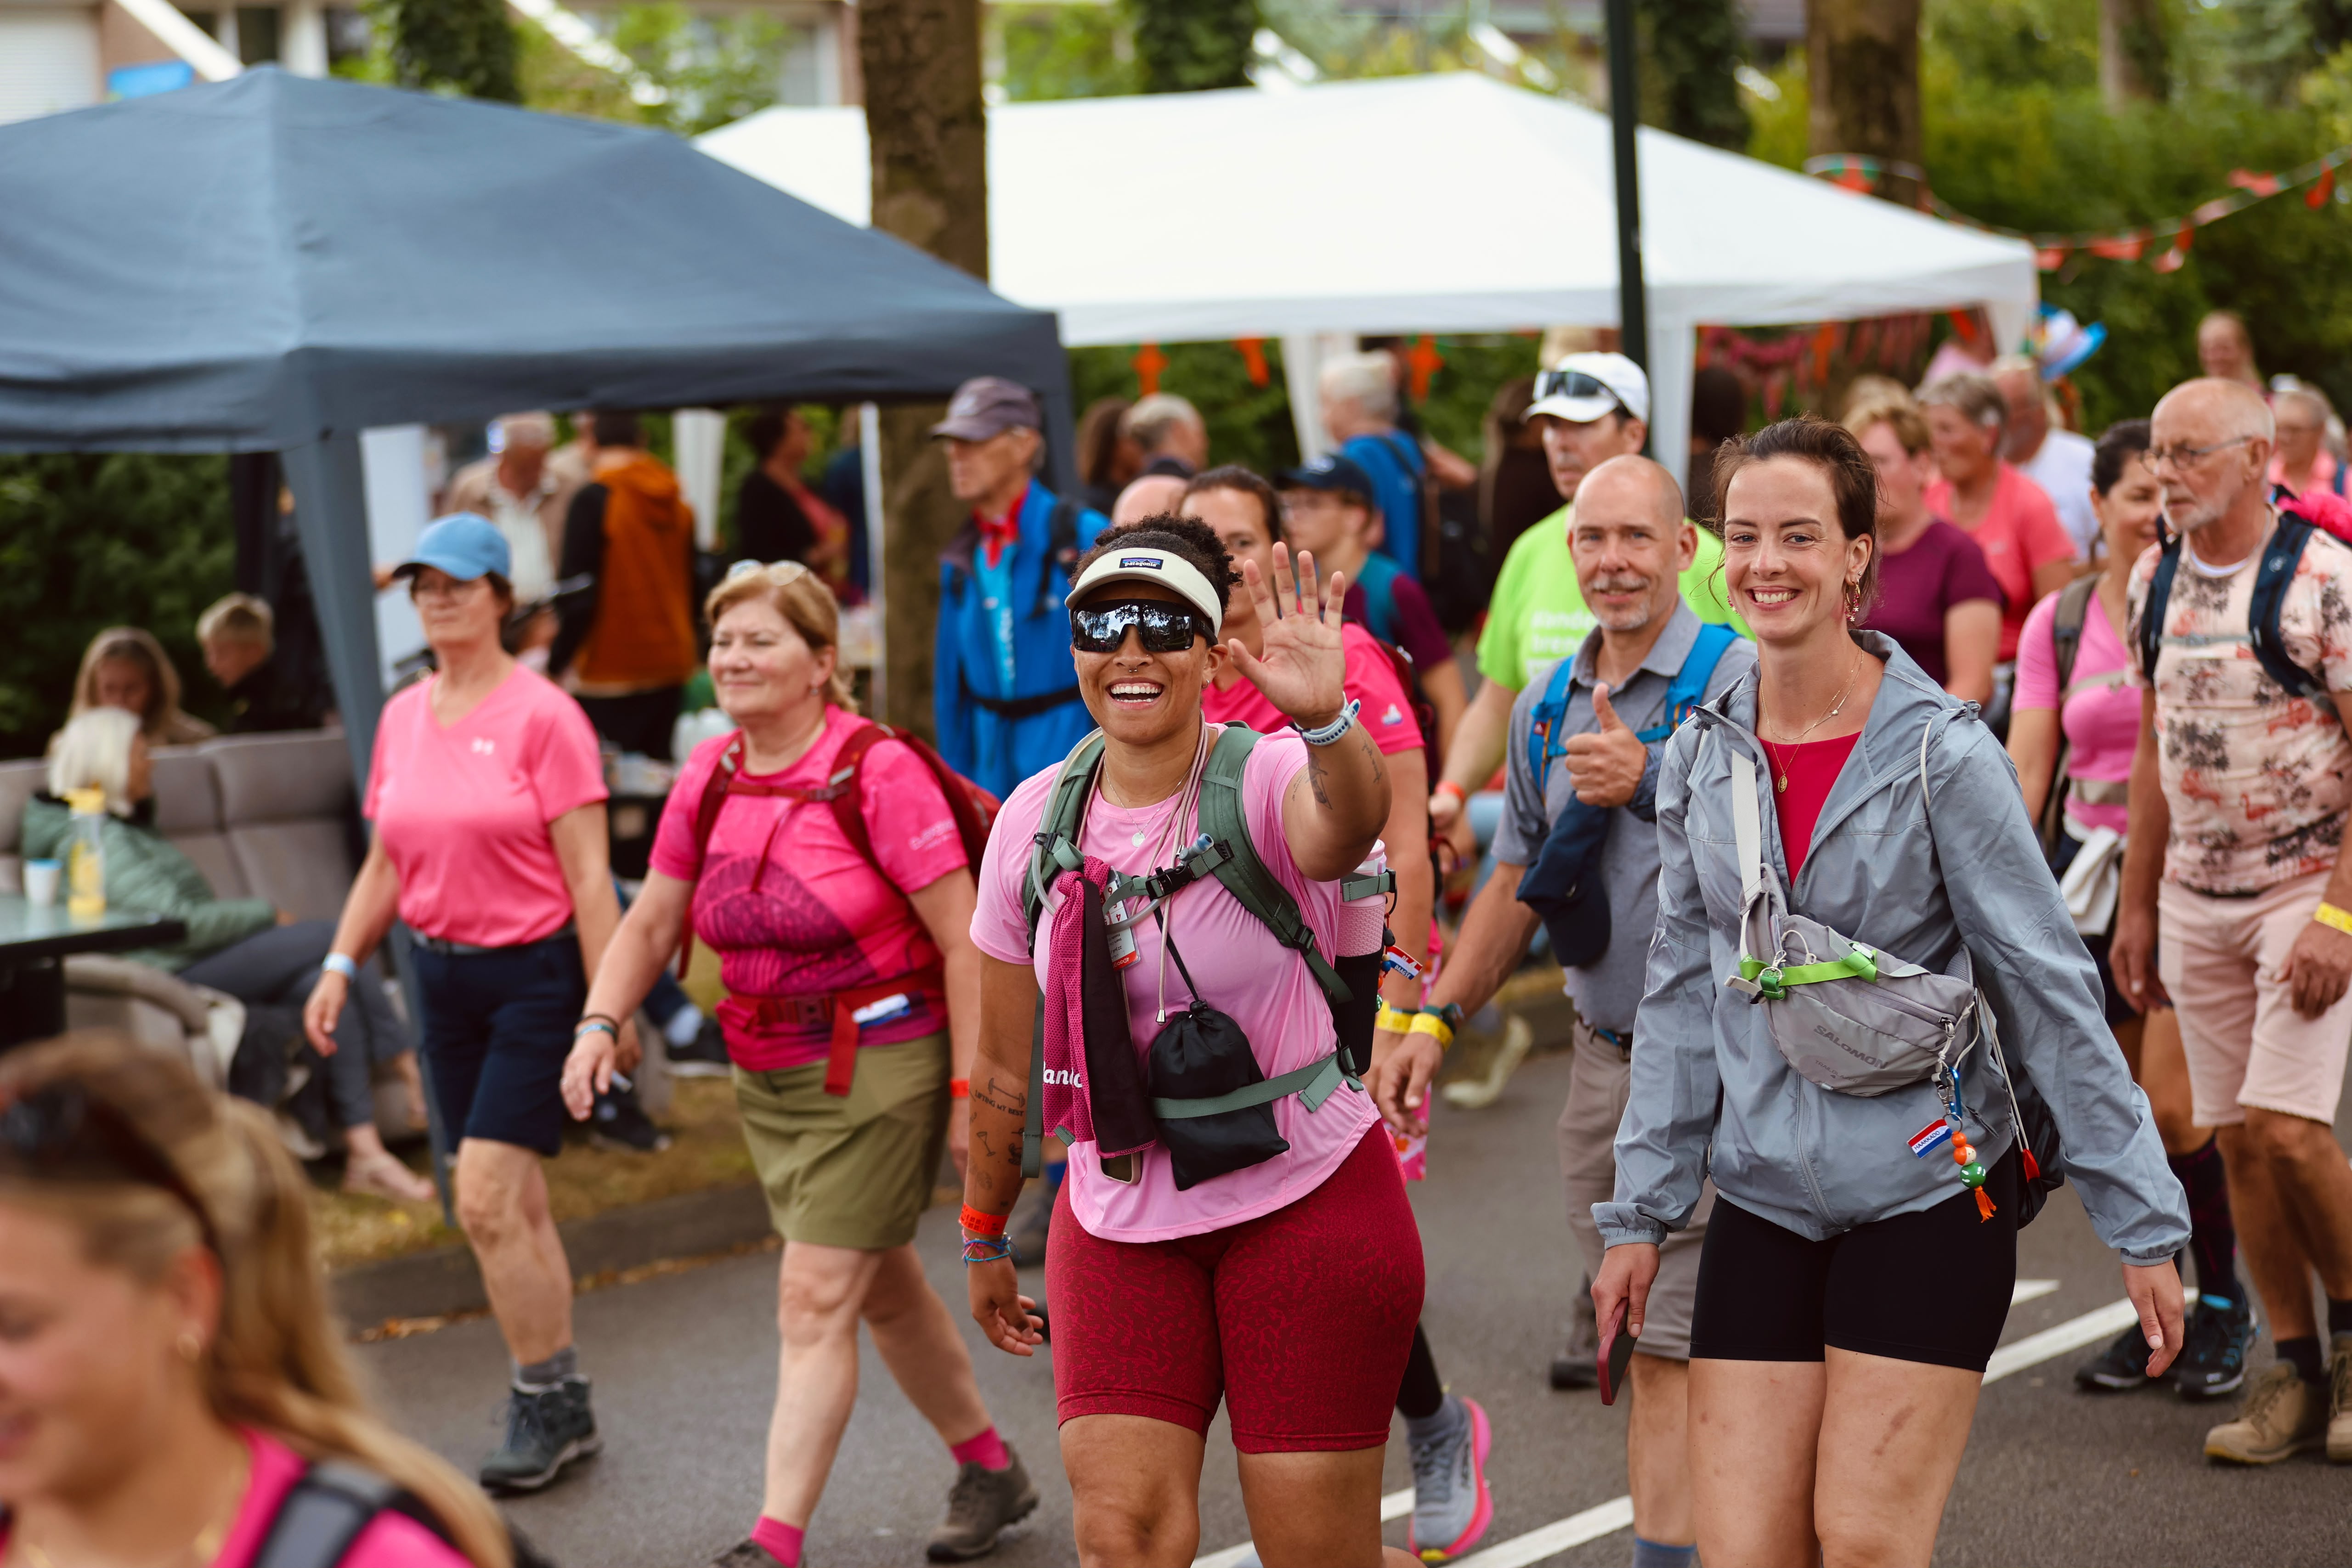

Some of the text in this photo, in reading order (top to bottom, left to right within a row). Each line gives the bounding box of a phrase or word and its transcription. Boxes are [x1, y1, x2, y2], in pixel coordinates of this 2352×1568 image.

[1108, 887, 1113, 895] 6
[1394, 965, 1411, 978] DAAGSE
[1814, 1025, 1889, 1069] SALOMON
[1008, 1107, 1024, 1116] BEST
[1914, 1131, 1940, 1150] HAAKKADO
